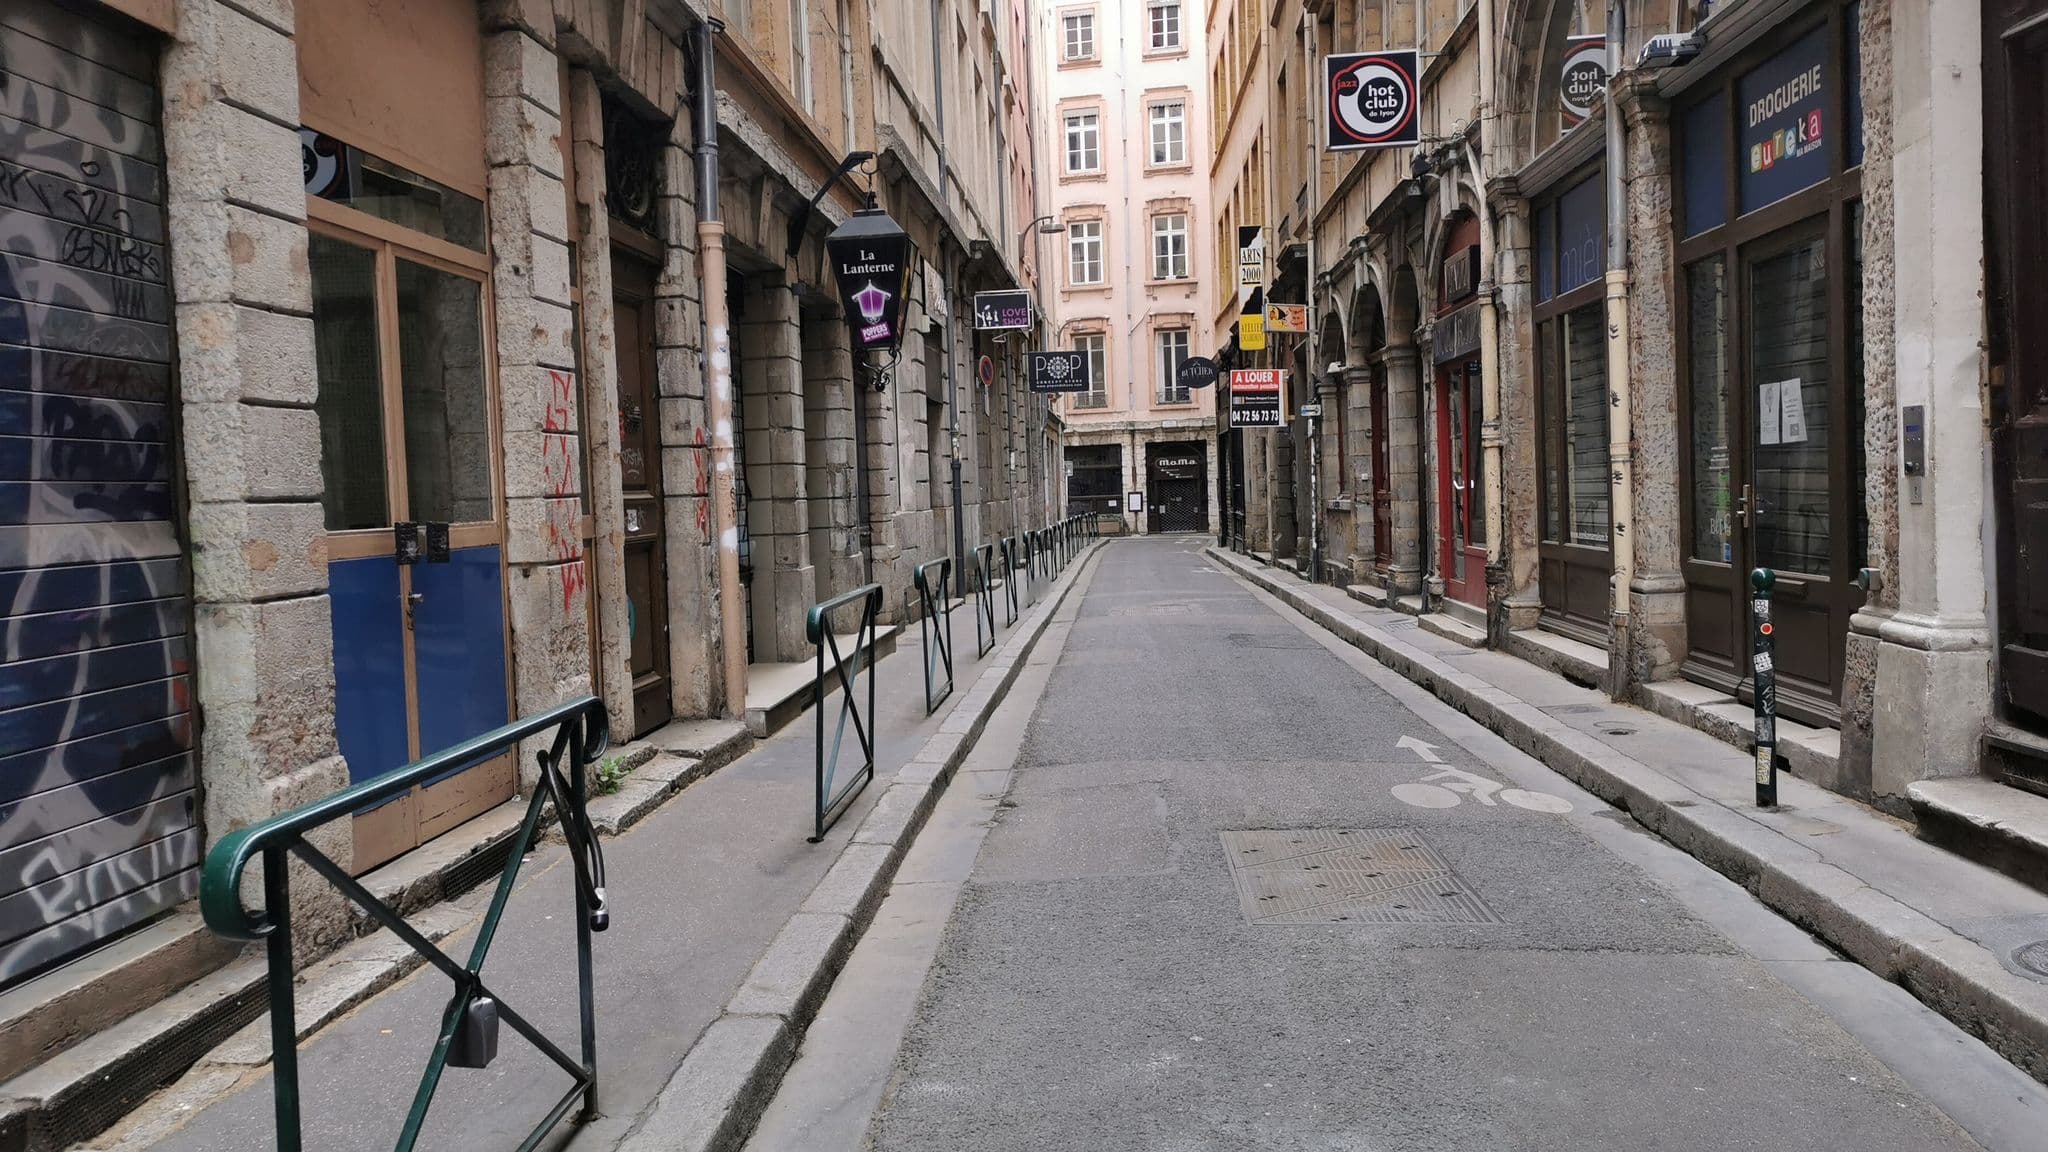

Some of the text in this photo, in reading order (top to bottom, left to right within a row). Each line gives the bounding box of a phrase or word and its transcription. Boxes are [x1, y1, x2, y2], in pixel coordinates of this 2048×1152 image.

[1337, 80, 1357, 91] jazz
[1368, 84, 1395, 97] hot
[1365, 95, 1398, 109] club
[1749, 64, 1821, 128] DROGUERIE
[1380, 109, 1395, 118] lyon
[1751, 113, 1821, 171] eureka
[1803, 138, 1822, 155] MAISON
[860, 249, 875, 261] La
[1242, 248, 1261, 263] ARTS
[843, 263, 895, 275] Lanterne
[1242, 268, 1261, 281] 2000
[1002, 308, 1027, 317] LOVE
[1002, 317, 1027, 326] SHOP
[862, 323, 888, 338] POPPERS
[1235, 371, 1274, 384] A LOUER
[1232, 410, 1279, 422] 04 72 56 73 73
